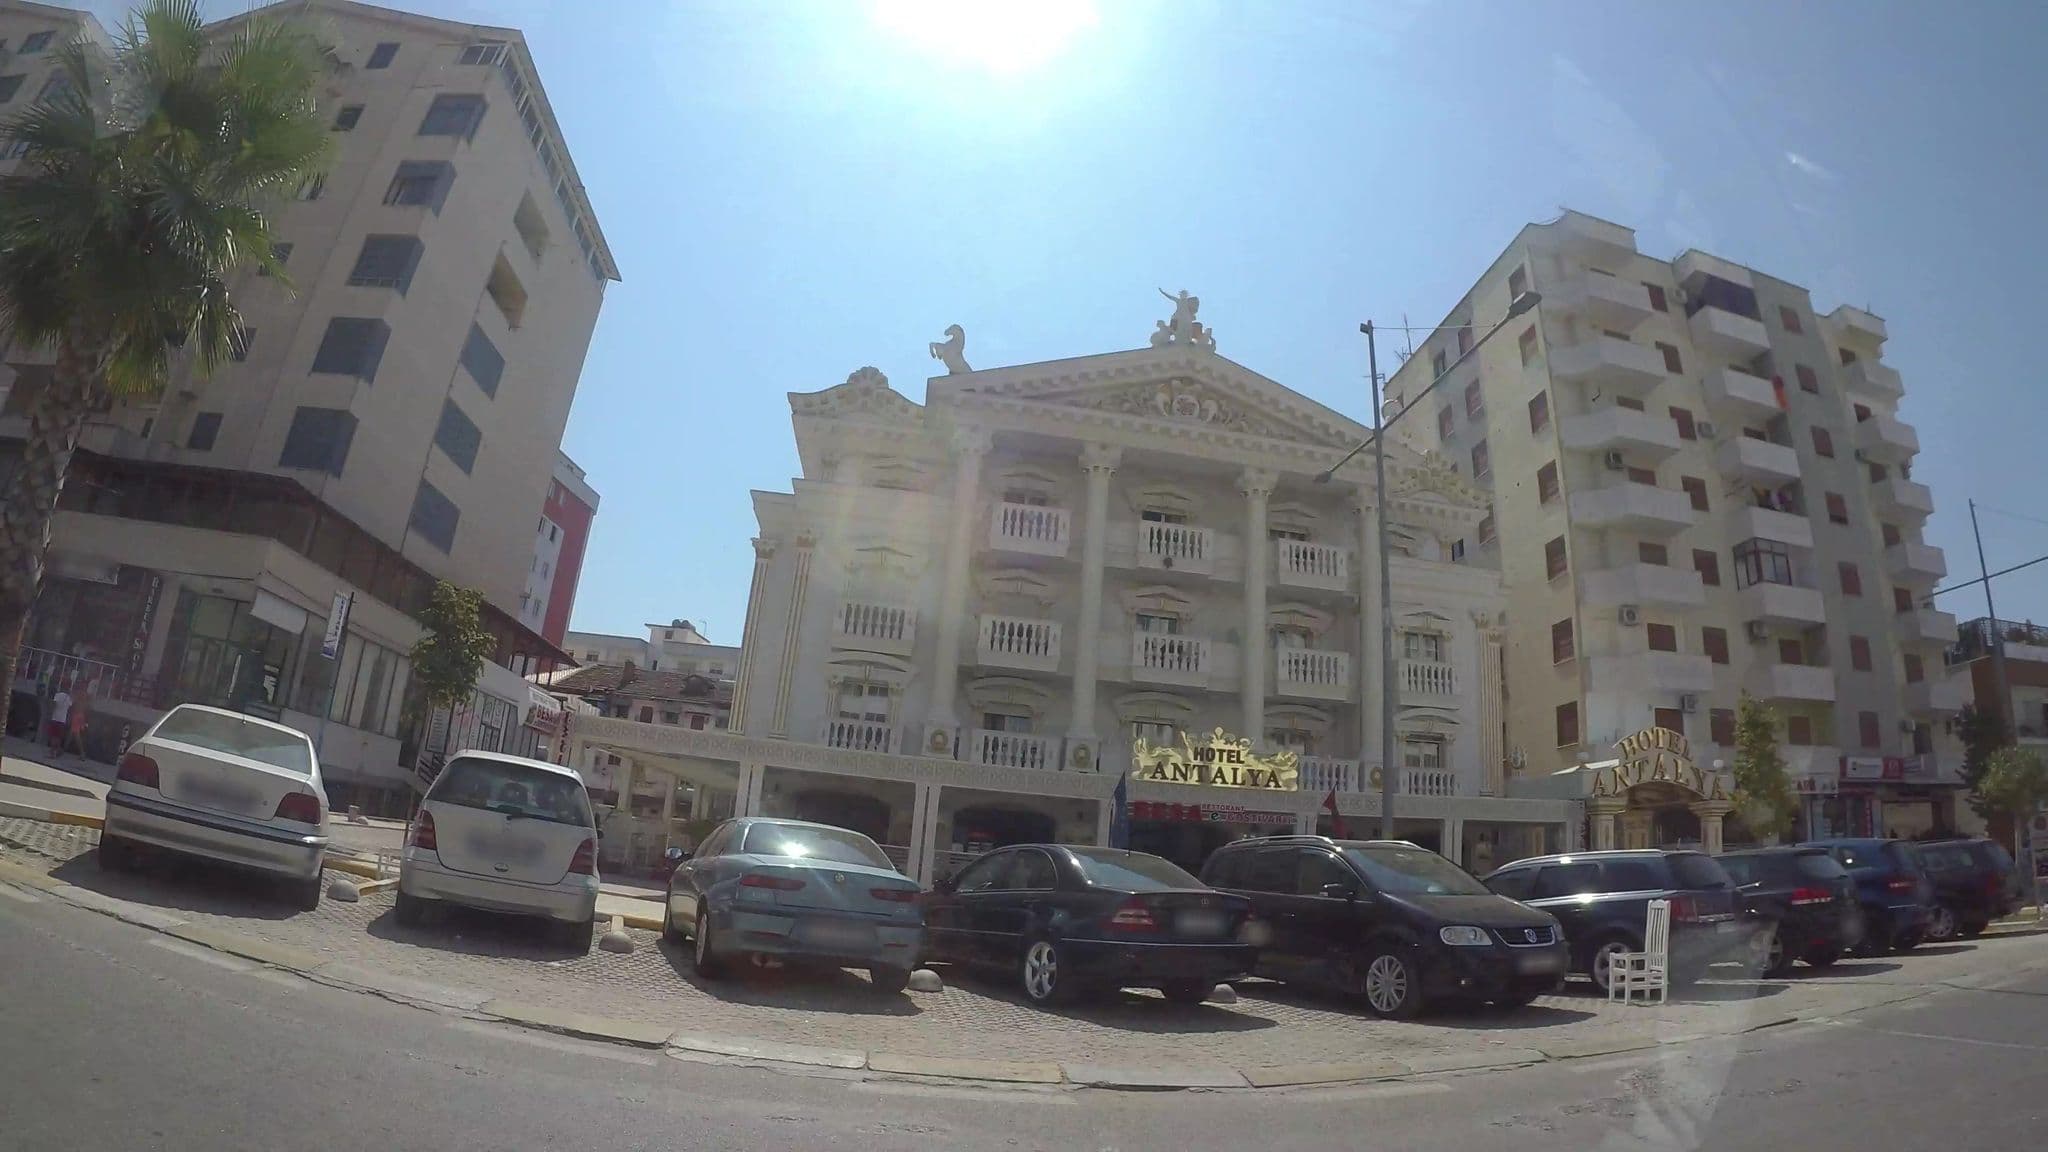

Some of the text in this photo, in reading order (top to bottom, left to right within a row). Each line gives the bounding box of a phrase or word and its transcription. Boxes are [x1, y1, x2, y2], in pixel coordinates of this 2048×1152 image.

[1193, 746, 1246, 765] HOTEL
[1619, 726, 1693, 762] HOTEL
[1149, 760, 1283, 789] ANTALYA
[1592, 752, 1728, 801] ANTALYA
[1201, 803, 1246, 812] RESTORANT
